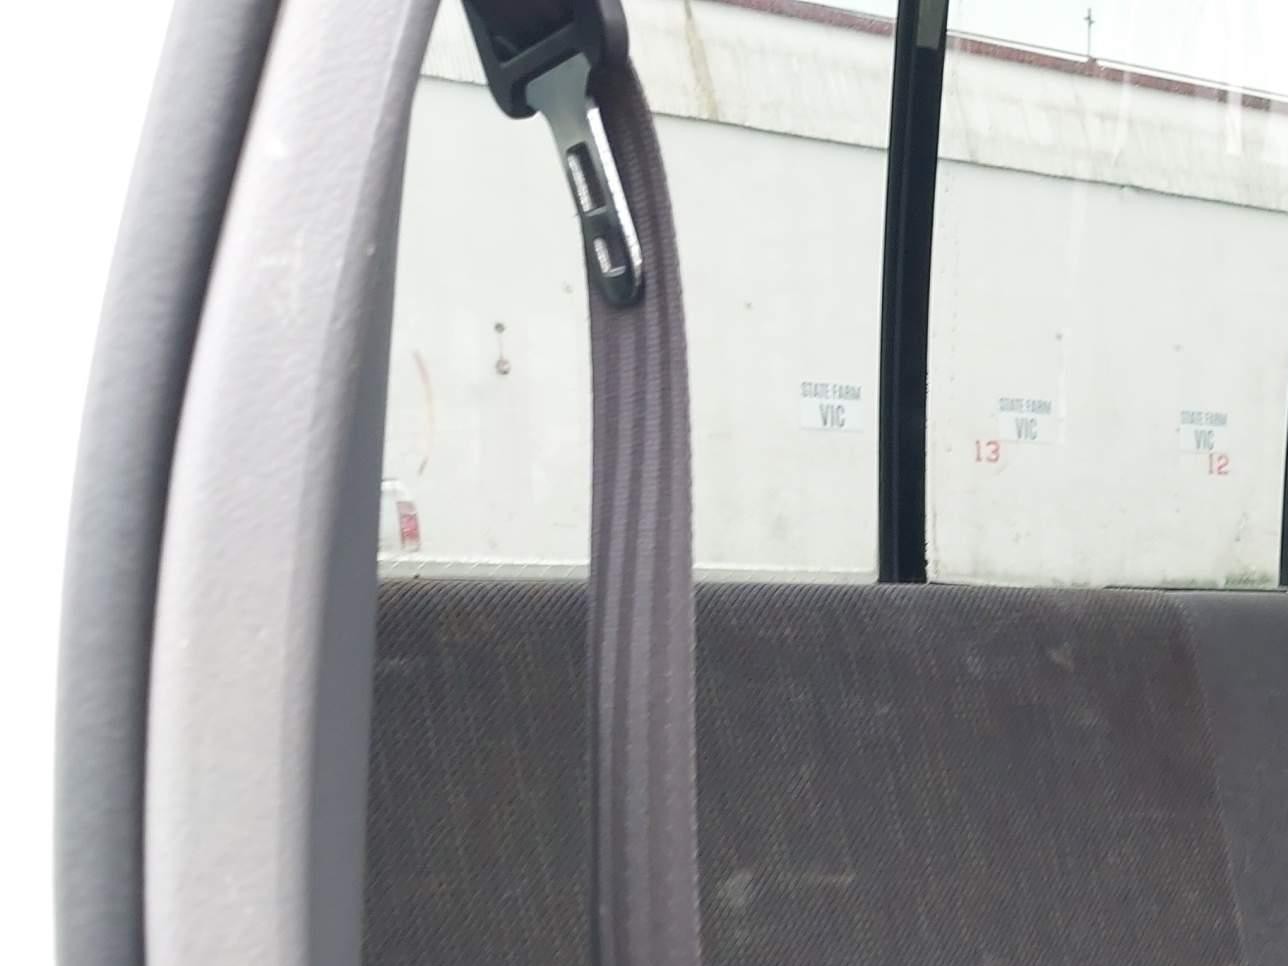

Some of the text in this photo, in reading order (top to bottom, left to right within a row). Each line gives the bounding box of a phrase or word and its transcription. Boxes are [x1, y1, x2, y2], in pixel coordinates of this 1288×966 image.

[800, 381, 862, 400] STATE FARM
[819, 404, 846, 429] VIC
[998, 397, 1052, 415] STATE FARM
[1014, 417, 1038, 441] VIC
[1194, 429, 1215, 451] VIC
[974, 439, 1000, 463] 13
[1208, 453, 1230, 476] 12
